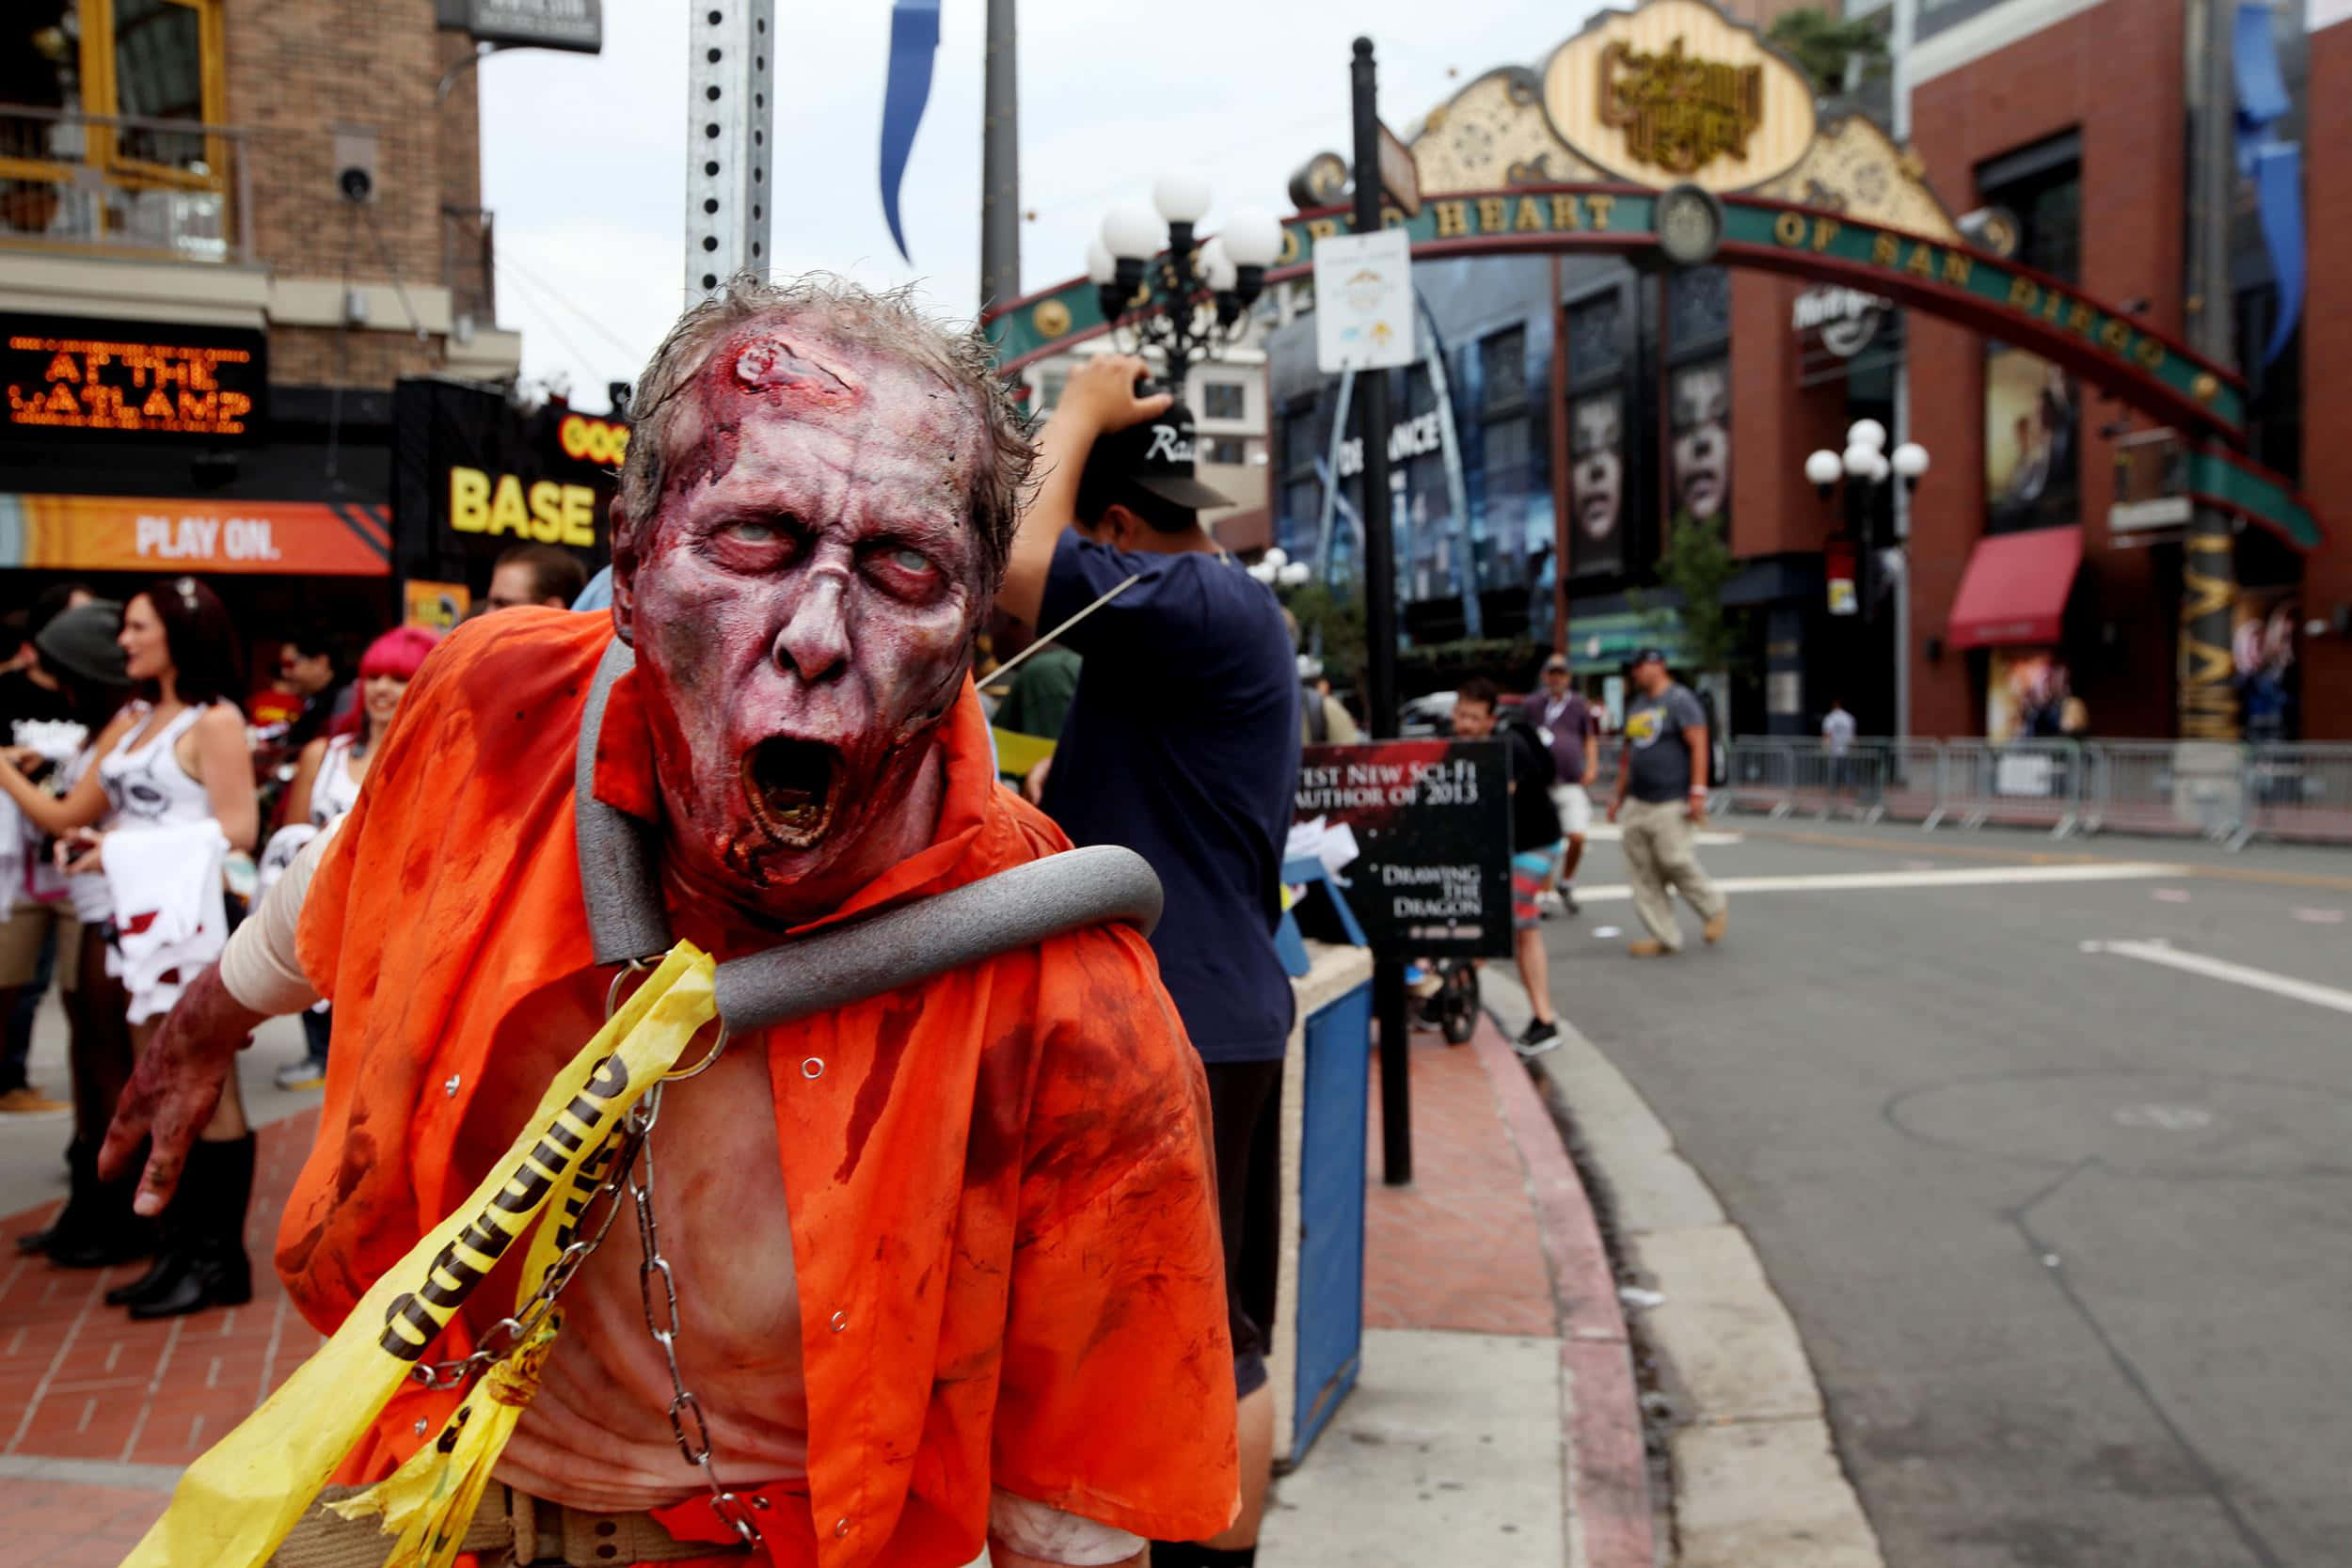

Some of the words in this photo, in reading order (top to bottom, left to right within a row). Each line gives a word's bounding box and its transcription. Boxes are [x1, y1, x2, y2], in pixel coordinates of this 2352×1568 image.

[1435, 194, 1614, 237] HEART
[1774, 212, 1841, 251] OF
[1871, 231, 1974, 286] SAN
[2008, 276, 2164, 368] DIEGO
[46, 348, 111, 387] AT
[121, 350, 218, 390] THE
[1339, 411, 1442, 477] DENCE
[450, 466, 596, 547] BASE
[136, 515, 218, 559] PLAY
[224, 517, 281, 560] ON.
[1298, 766, 1341, 786] EST
[1346, 763, 1405, 784] NEW
[1295, 786, 1385, 809] AUTHOR
[1388, 786, 1419, 806] OF
[1424, 781, 1478, 805] 2013
[1383, 863, 1482, 886] DRAWING
[1442, 881, 1478, 899] THE
[1393, 896, 1483, 918] DRAGON
